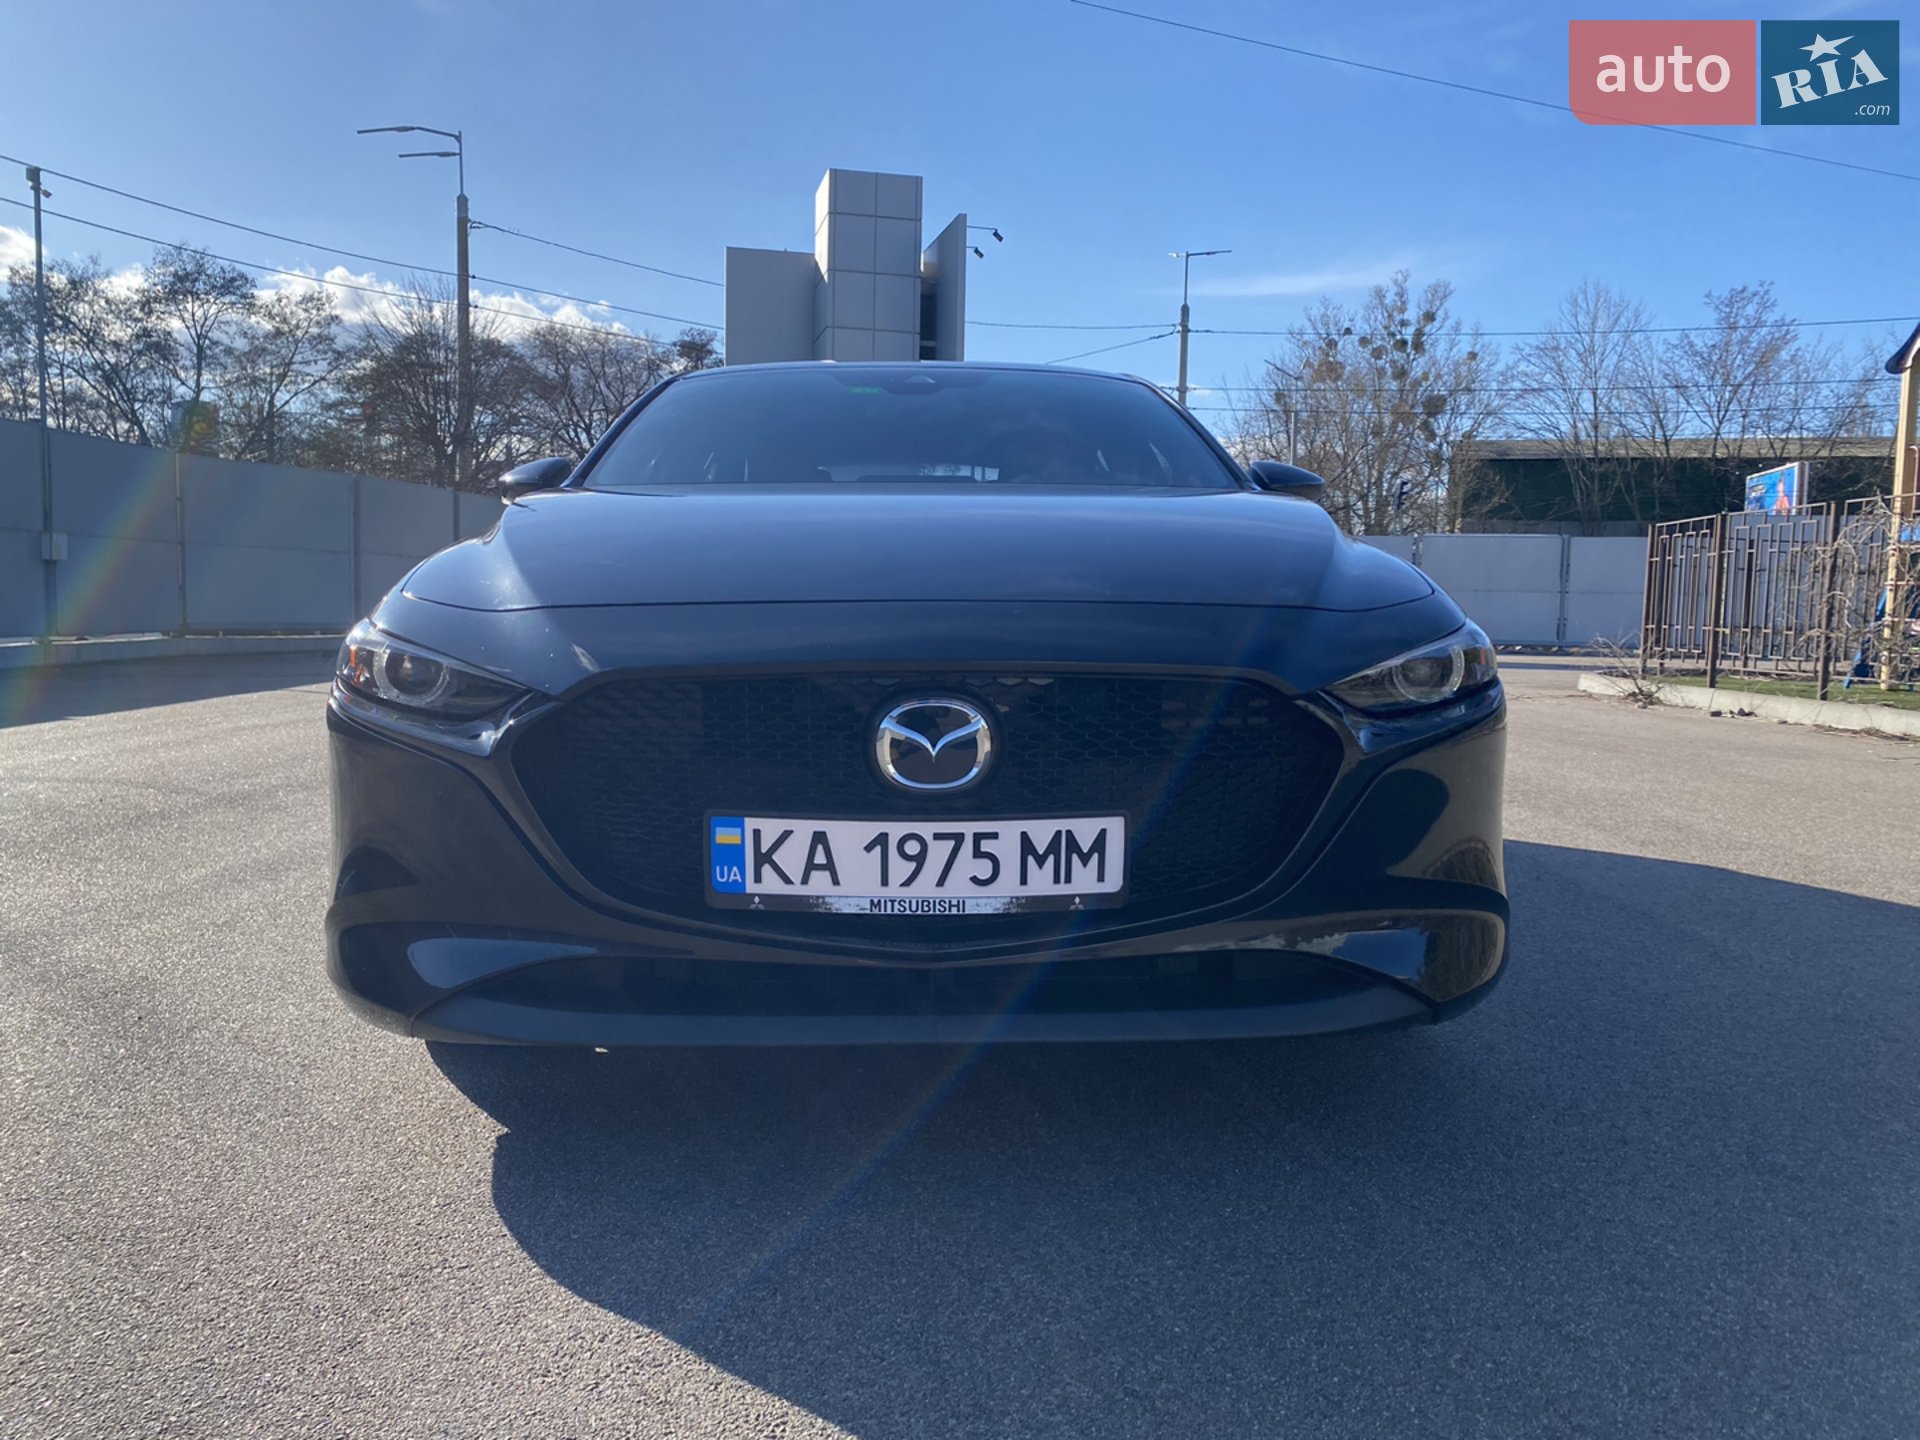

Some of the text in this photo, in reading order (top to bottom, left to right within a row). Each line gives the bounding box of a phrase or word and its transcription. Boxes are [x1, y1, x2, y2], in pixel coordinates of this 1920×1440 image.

[752, 827, 1107, 888] KA 1975 MM
[716, 866, 743, 884] UA
[868, 898, 967, 914] MITSUBISHI
